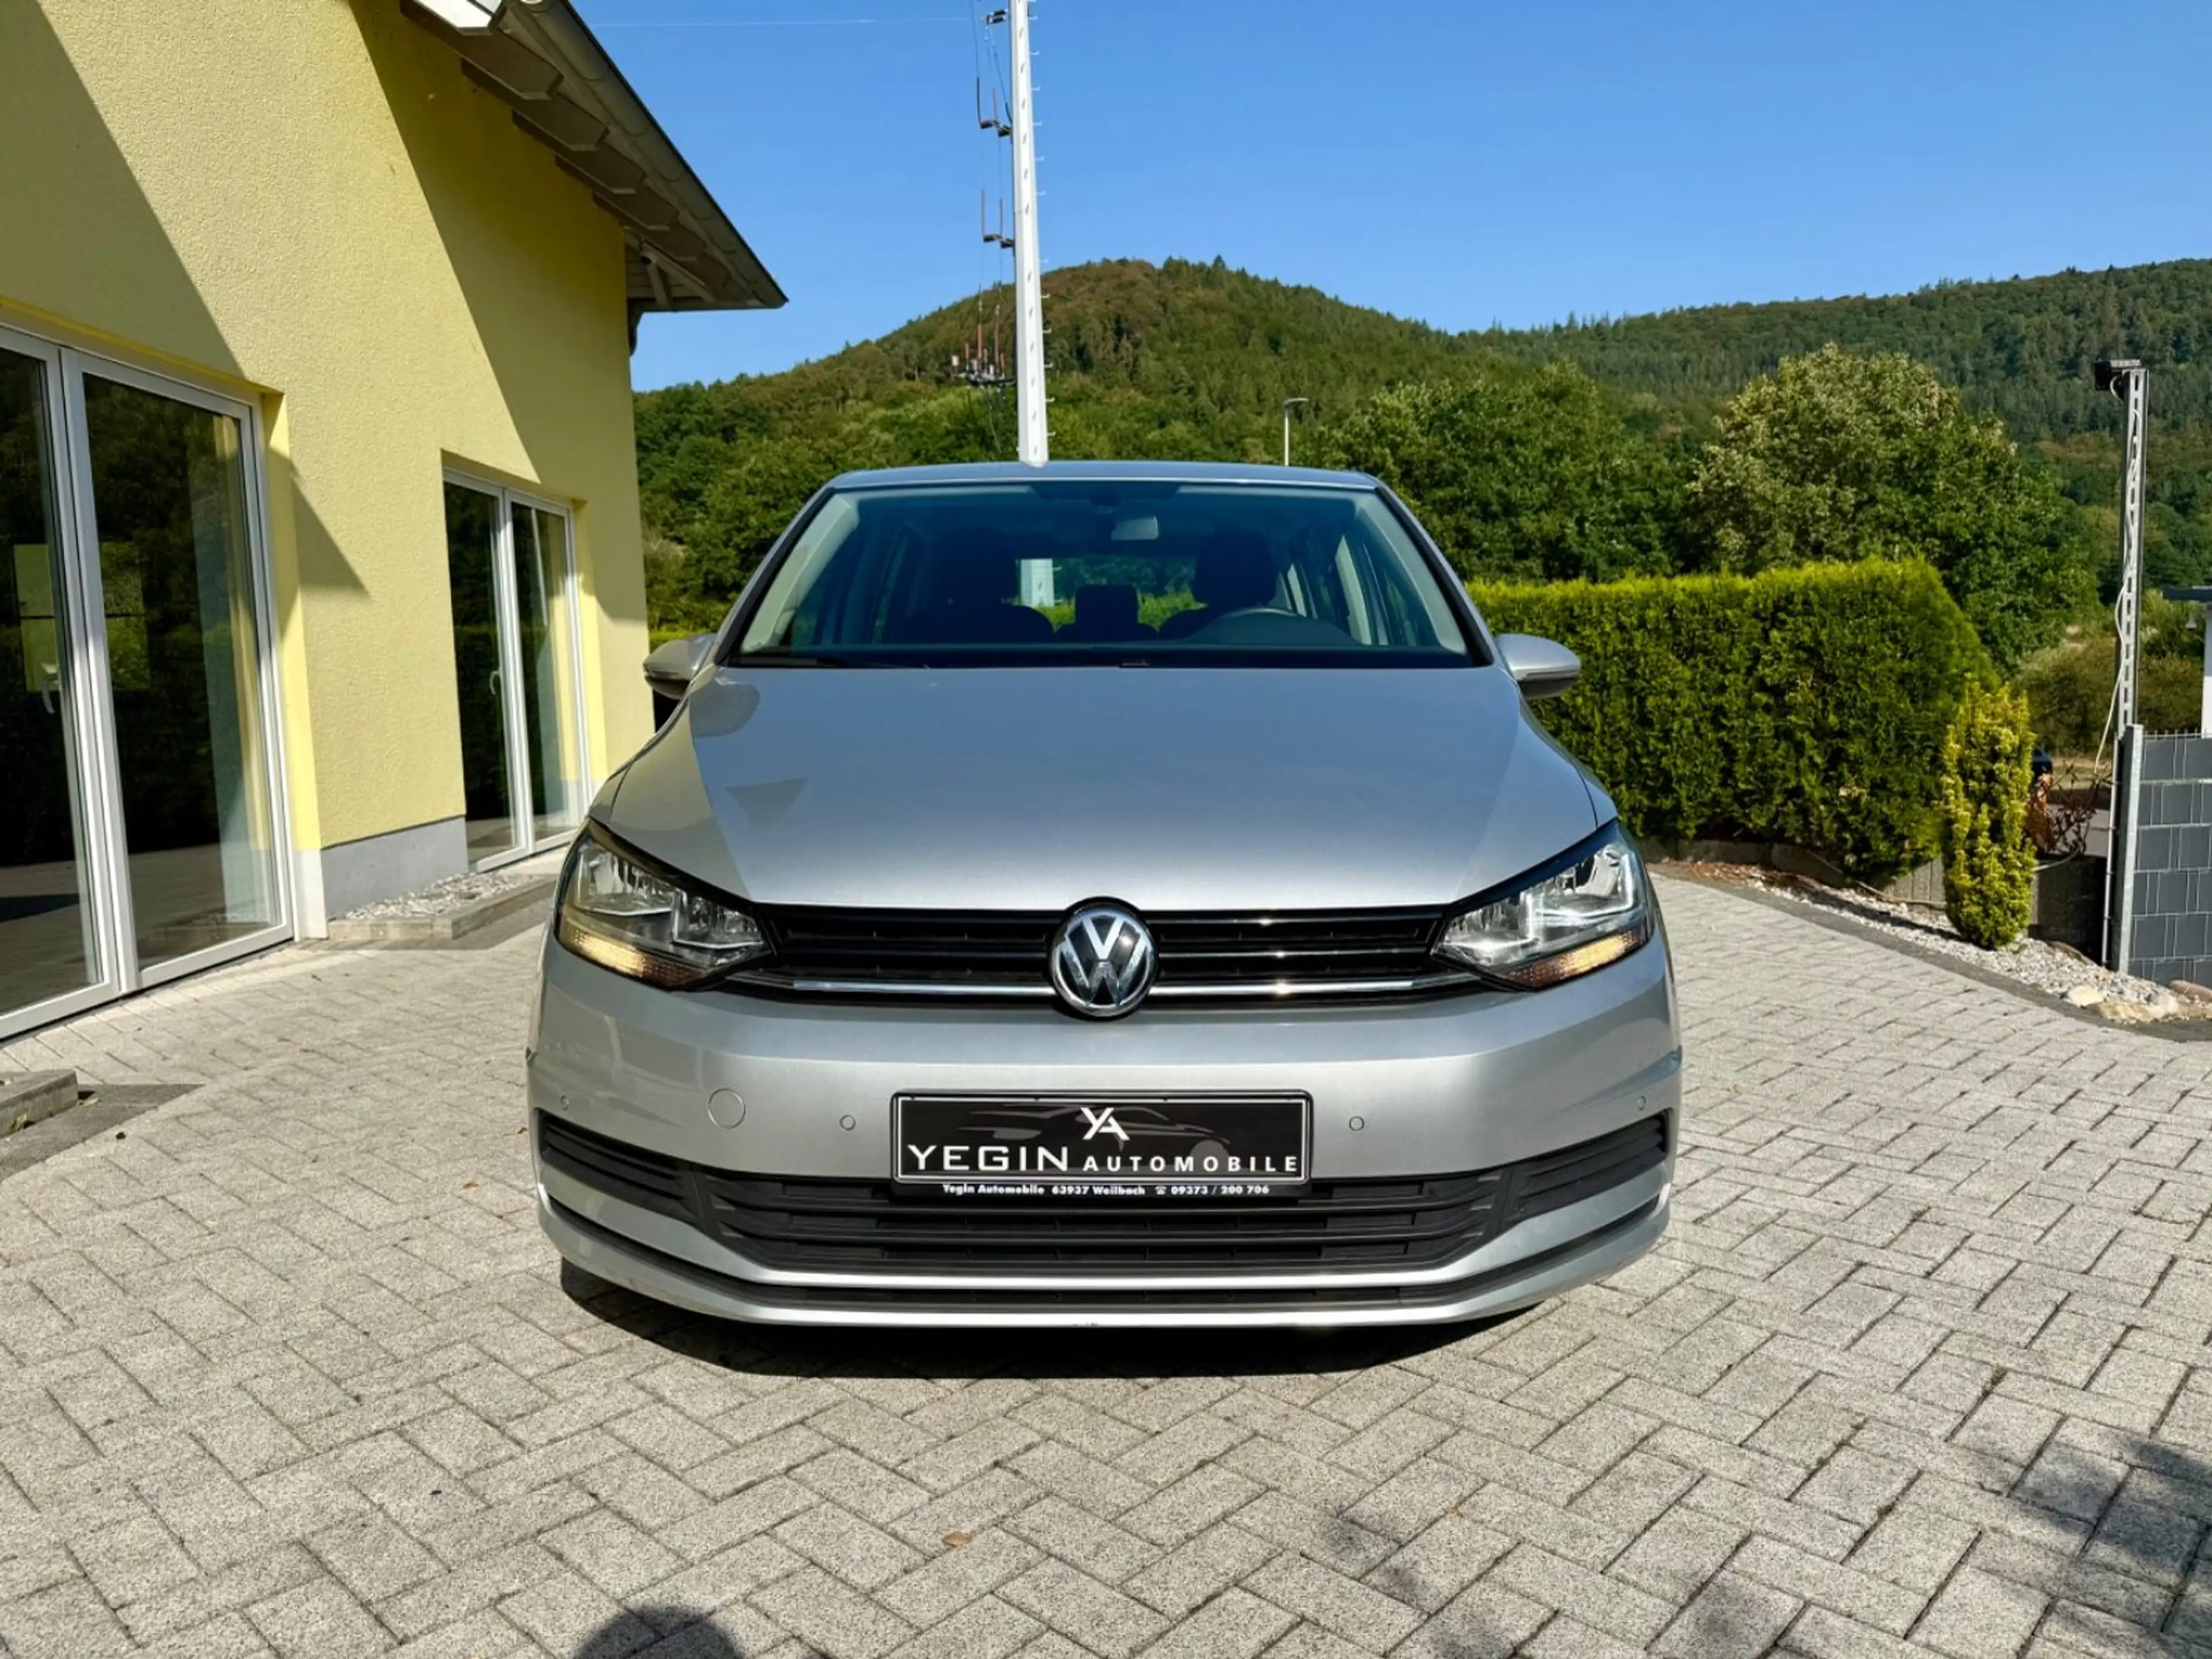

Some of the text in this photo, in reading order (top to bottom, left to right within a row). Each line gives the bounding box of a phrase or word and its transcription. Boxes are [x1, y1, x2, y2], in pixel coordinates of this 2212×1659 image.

[1055, 910, 1152, 1008] VW
[907, 1145, 1297, 1172] YEGIN AUTOMOBILE
[942, 1183, 975, 1195] Yegin
[978, 1184, 1044, 1195] Automobile
[1052, 1185, 1089, 1195] 63937
[1092, 1185, 1146, 1195] Weilbach
[1171, 1185, 1209, 1195] 09373
[1220, 1185, 1243, 1195] 200
[1246, 1185, 1270, 1195] 706
